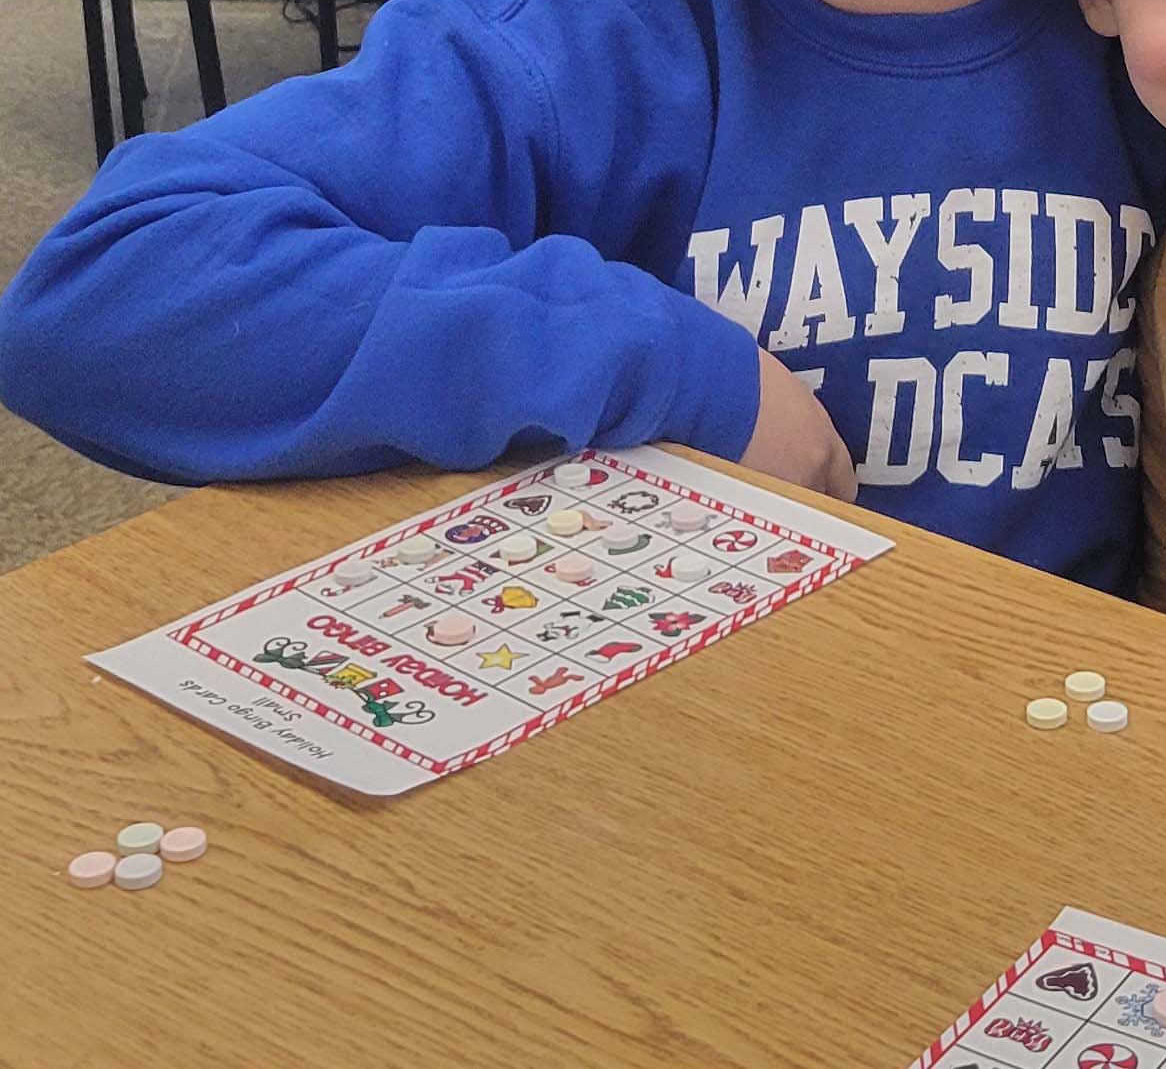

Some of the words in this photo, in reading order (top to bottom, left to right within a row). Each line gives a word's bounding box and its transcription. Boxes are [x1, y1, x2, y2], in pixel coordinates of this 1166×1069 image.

[178, 679, 227, 706] Cards
[227, 704, 273, 731] Bingo
[250, 696, 302, 723] Small
[271, 727, 334, 760] Holiday
